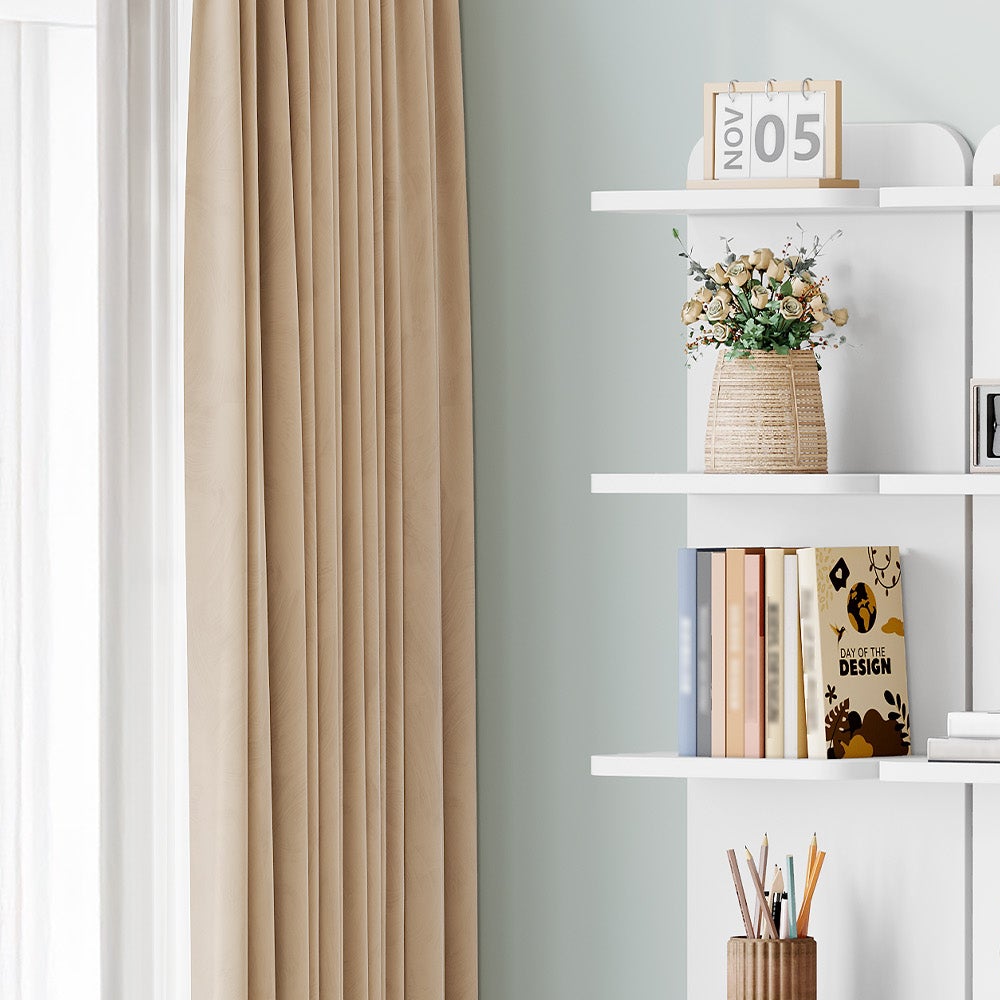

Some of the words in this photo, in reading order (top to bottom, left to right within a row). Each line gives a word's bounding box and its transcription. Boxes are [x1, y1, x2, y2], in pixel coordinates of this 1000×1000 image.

[723, 107, 744, 170] NOV
[754, 113, 821, 163] 05
[839, 658, 891, 676] DESIGN
[840, 647, 856, 658] DAY
[857, 647, 868, 658] OF
[870, 647, 886, 657] THE
